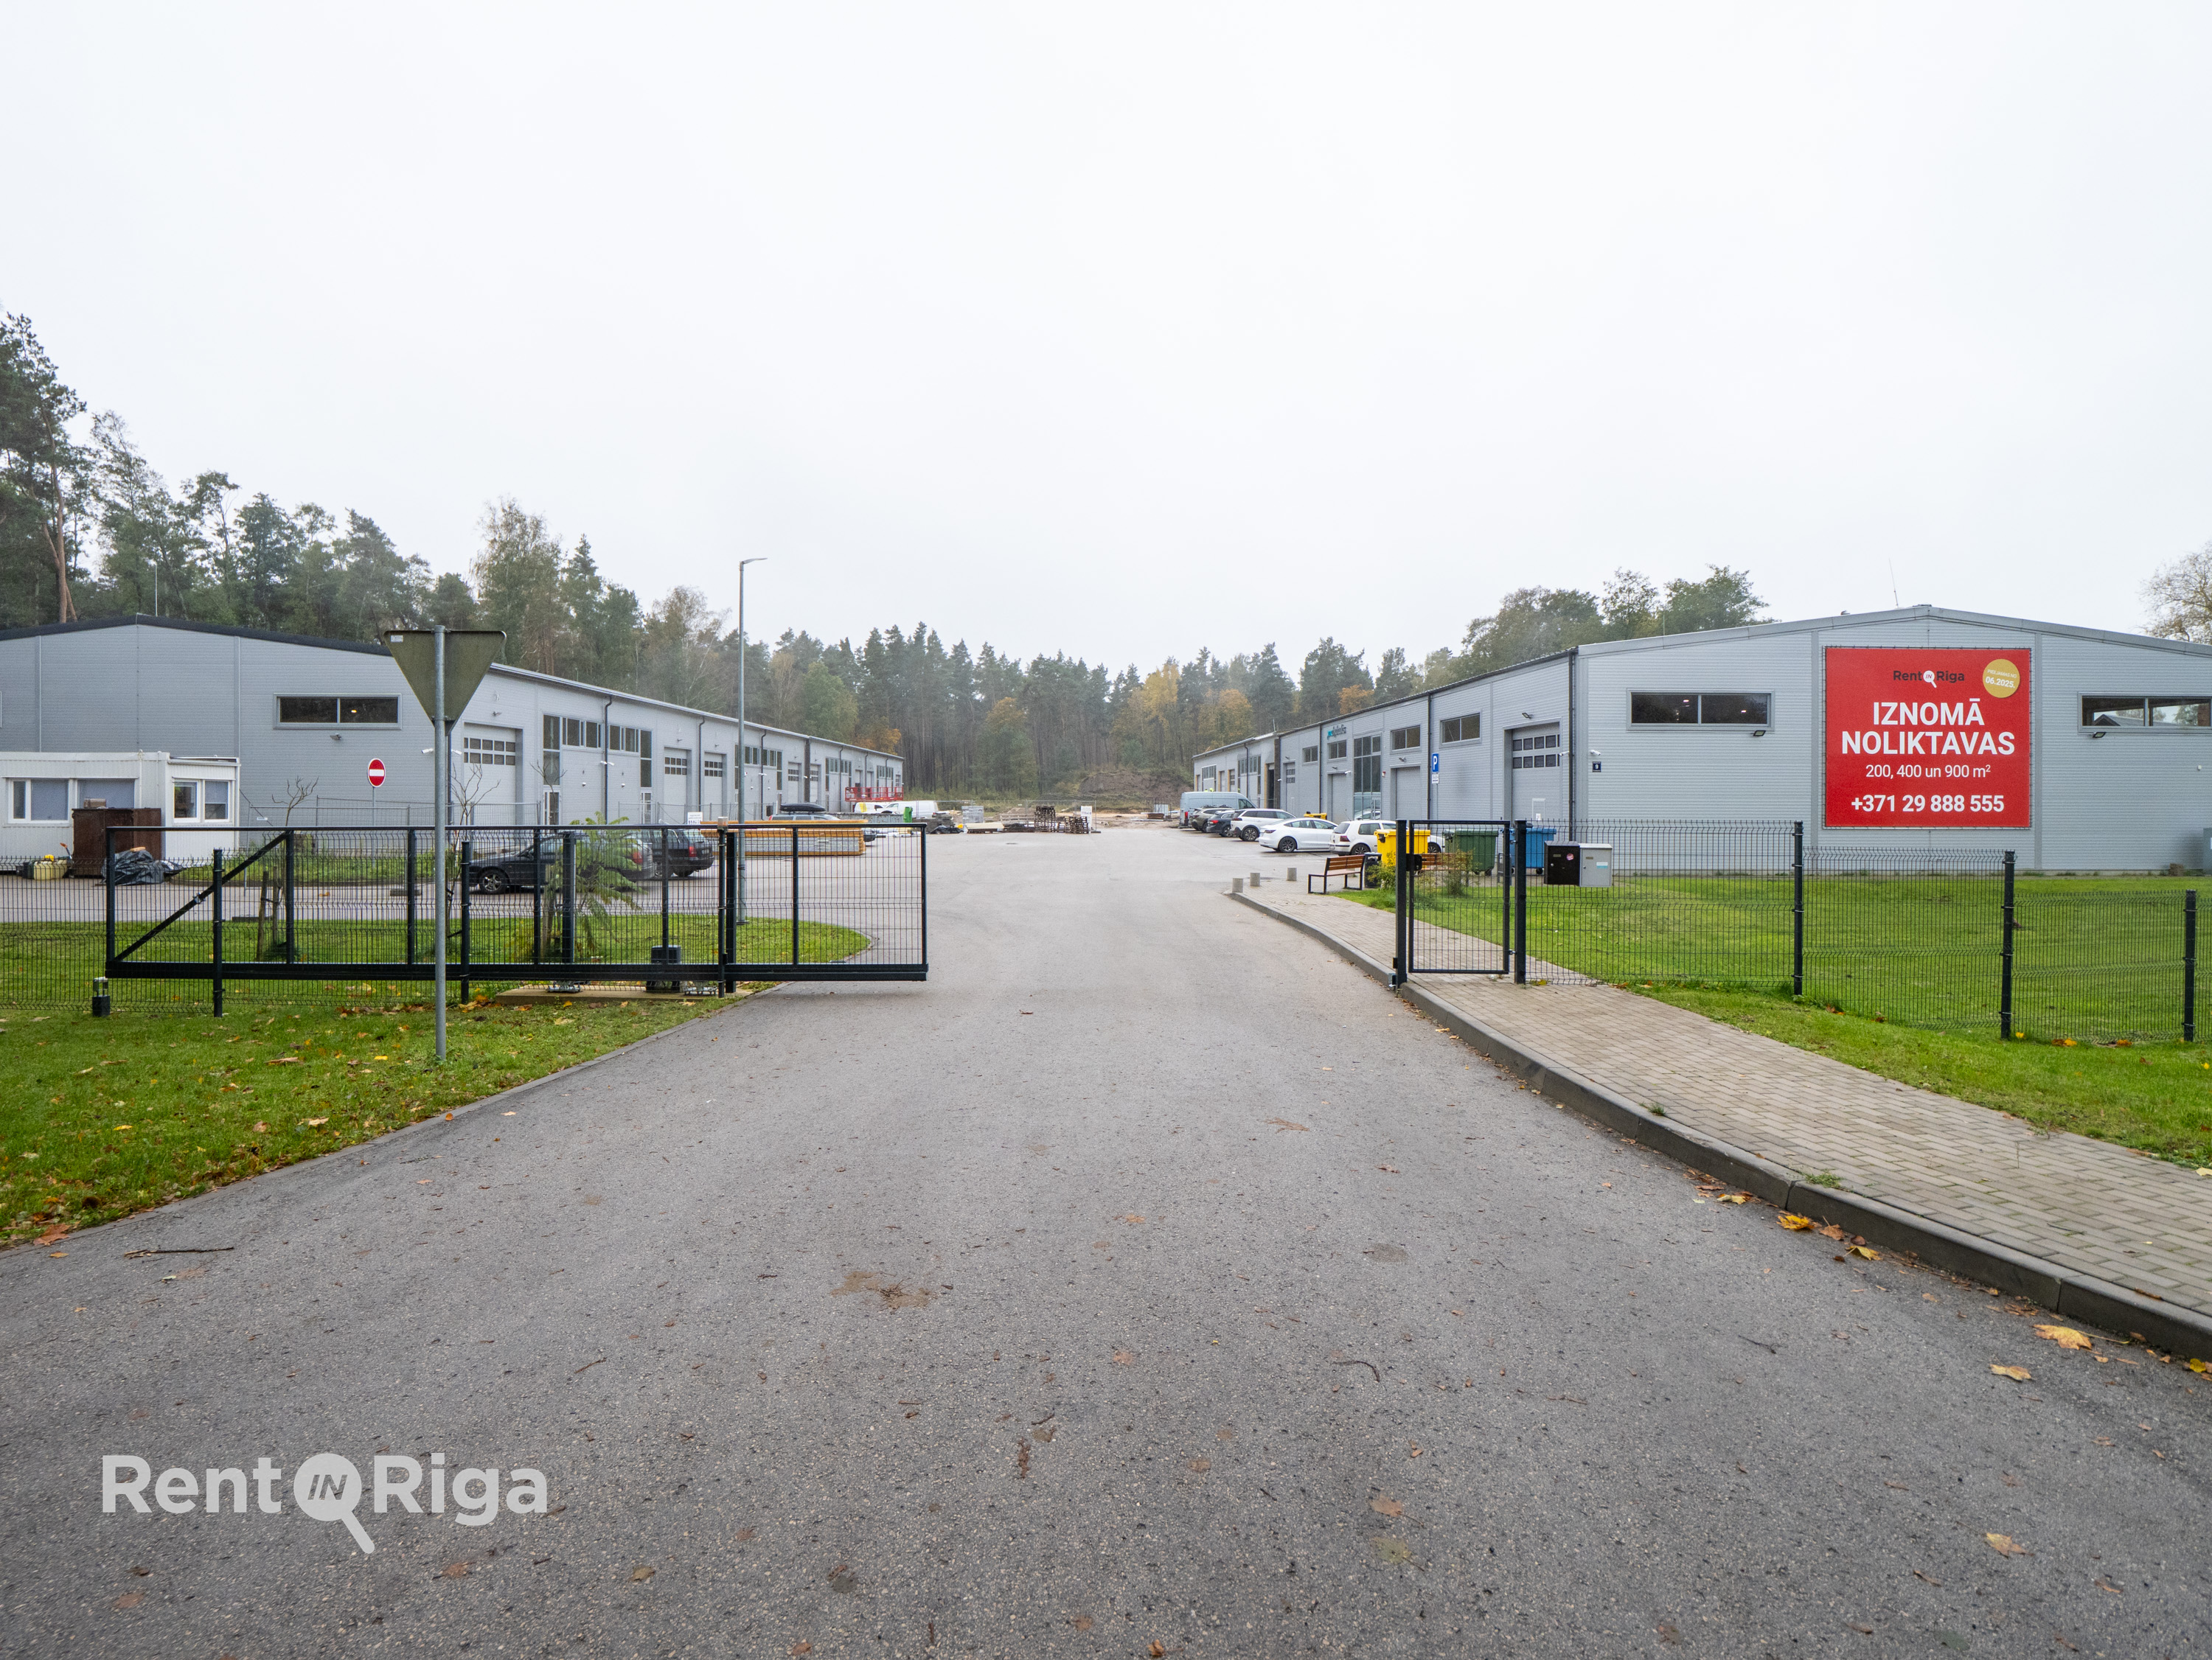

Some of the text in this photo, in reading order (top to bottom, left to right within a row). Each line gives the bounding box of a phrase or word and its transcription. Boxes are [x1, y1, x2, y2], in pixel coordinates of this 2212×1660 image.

[1893, 670, 1922, 681] Rent
[1936, 671, 1965, 683] Riga
[1985, 676, 2015, 688] 06.2025.
[1873, 698, 1985, 725] IZNOMĀ
[1842, 731, 2015, 755] NOLIKTAVAS
[1433, 756, 1438, 770] P
[1865, 764, 1893, 779] 200,
[1896, 764, 1921, 778] 400
[1925, 767, 1941, 778] un
[1944, 764, 1969, 778] 900
[1851, 795, 2004, 812] +371 29 888 555
